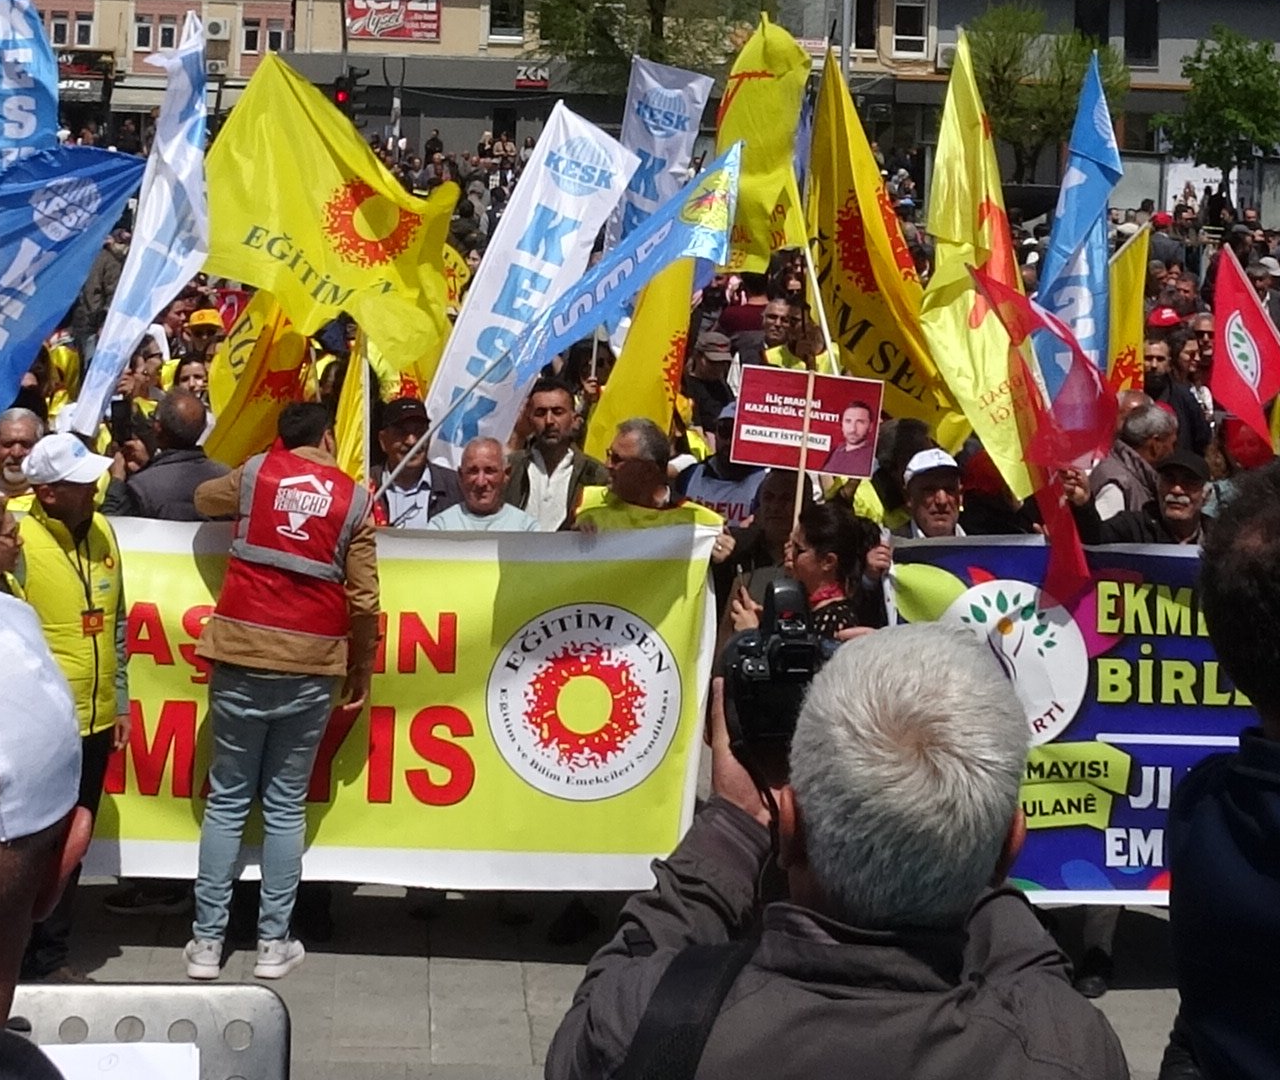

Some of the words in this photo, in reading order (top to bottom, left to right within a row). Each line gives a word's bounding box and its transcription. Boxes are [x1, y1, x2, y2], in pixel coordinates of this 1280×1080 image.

[543, 149, 619, 192] KESK
[241, 224, 355, 307] EĞİTİM
[744, 403, 770, 414] KAZA
[770, 405, 797, 417] DEĞİL
[745, 428, 780, 440] ADALET
[301, 494, 328, 513] CHP
[504, 609, 615, 675] EĞİTİM
[621, 622, 671, 676] SEN
[1026, 760, 1109, 780] MAYIS!
[1020, 793, 1097, 818] ULANÊ
